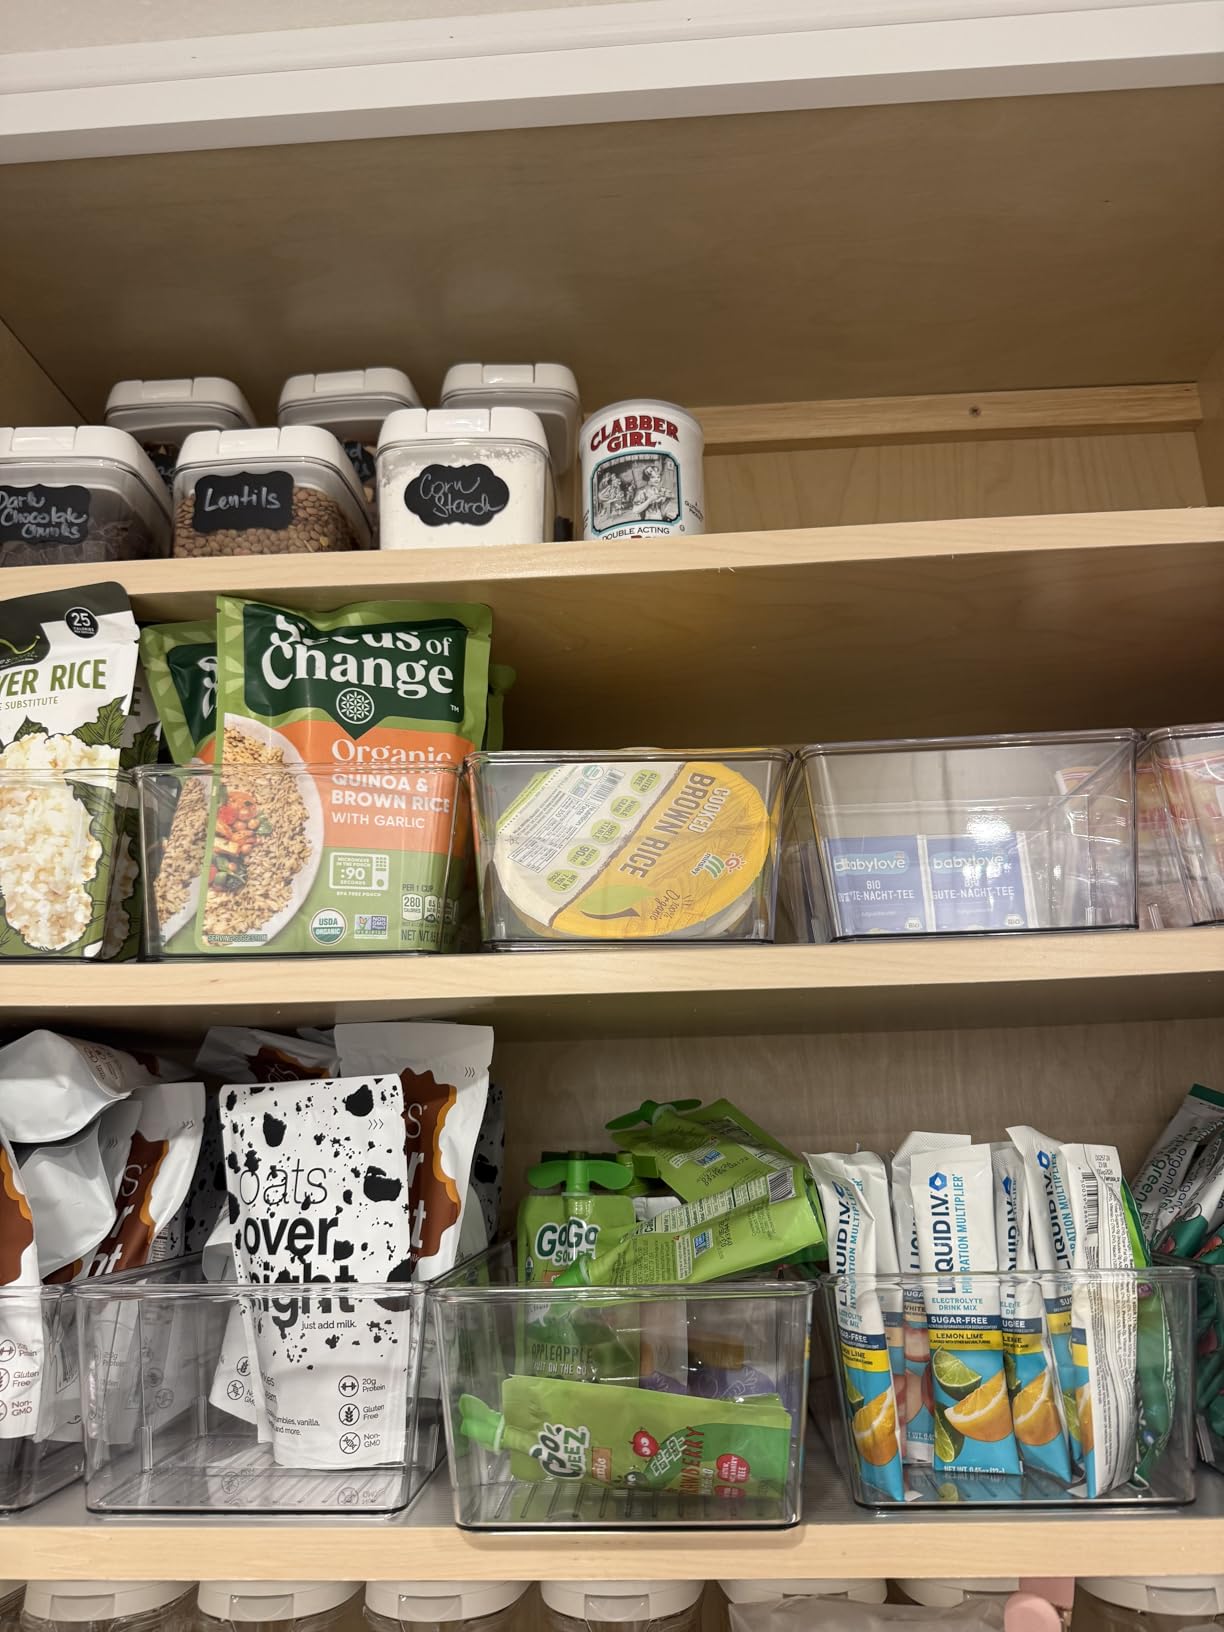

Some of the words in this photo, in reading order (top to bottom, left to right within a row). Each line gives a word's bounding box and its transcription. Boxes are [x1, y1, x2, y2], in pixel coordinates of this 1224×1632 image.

[590, 415, 679, 451] CLABBER
[607, 431, 657, 452] GIRL
[419, 473, 481, 498] Corn
[204, 486, 281, 513] Lentils
[602, 528, 635, 541] DOUBLE
[636, 526, 670, 534] ACTING
[72, 612, 90, 626] 25
[426, 637, 453, 656] of
[50, 658, 108, 692] RICE
[262, 643, 454, 699] Change
[5, 696, 58, 710] SUBSTITUTE
[332, 774, 410, 791] QUINOA
[416, 777, 428, 792] &
[332, 790, 406, 809] BROWN
[412, 796, 450, 813] RICE
[653, 772, 716, 836] BROWN
[688, 787, 730, 834] COOKED
[332, 812, 369, 824] WITH
[374, 815, 424, 828] GARLIC
[620, 836, 671, 878] RICE
[932, 854, 1004, 869] babylove
[866, 880, 881, 890] BIO
[404, 896, 420, 908] 280
[649, 889, 680, 921] Organic
[318, 918, 338, 926] USDA
[401, 930, 416, 940] NET
[1158, 1148, 1188, 1196] organic
[240, 1158, 328, 1206] oats
[1051, 1153, 1070, 1210] MULTIPLIER
[930, 1193, 950, 1217] I.V.
[952, 1175, 967, 1233] MULTIPLIER
[244, 1216, 339, 1256] over
[536, 1219, 600, 1258] GoGo
[301, 1320, 317, 1331] just
[318, 1320, 335, 1330] add
[336, 1319, 358, 1329] milk.
[930, 1316, 988, 1324] SUGAR-FREE
[14, 1371, 40, 1379] Gluten
[560, 1363, 574, 1374] THE
[12, 1379, 32, 1388] Free
[362, 1378, 376, 1386] 20g
[362, 1384, 386, 1393] Protein
[12, 1400, 32, 1408] Non-
[362, 1404, 385, 1413] Gluten
[12, 1408, 32, 1417] GMO
[362, 1413, 379, 1421] Free
[364, 1433, 380, 1441] Non-
[364, 1440, 381, 1448] GMO
